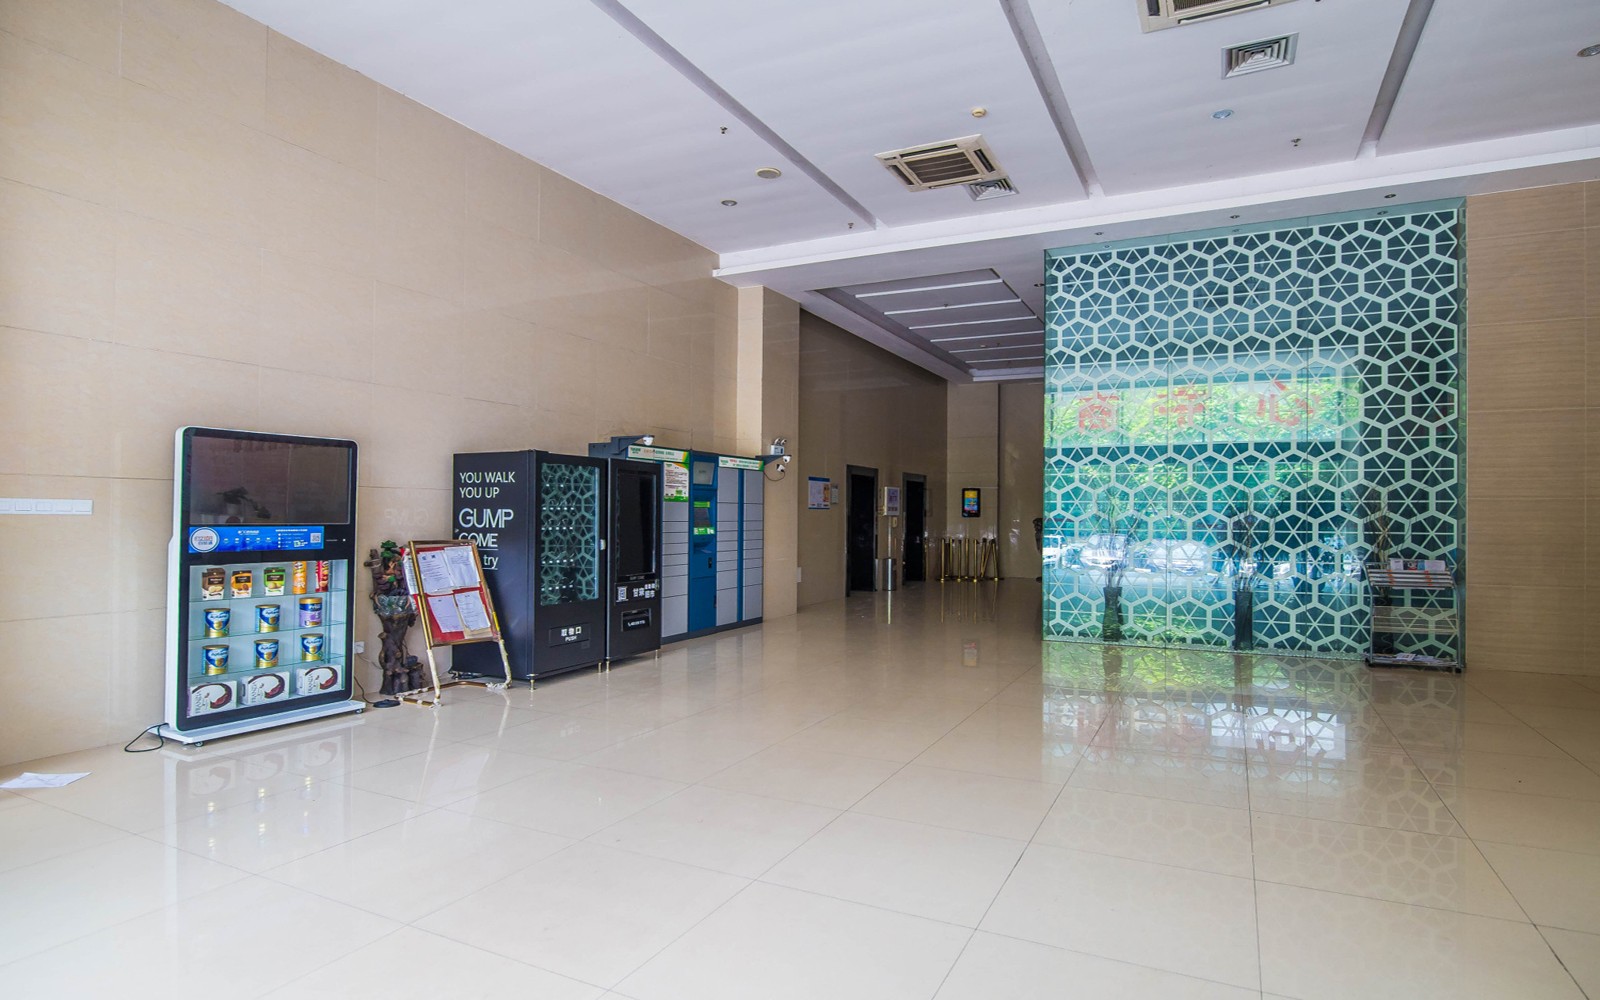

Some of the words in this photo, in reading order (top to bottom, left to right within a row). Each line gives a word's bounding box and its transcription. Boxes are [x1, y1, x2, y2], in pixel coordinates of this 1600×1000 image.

[459, 472, 482, 484] YOU
[484, 471, 516, 483] WALK
[459, 487, 482, 498] YOU
[484, 486, 500, 498] UP
[458, 507, 514, 528] GUMP
[458, 532, 498, 547] COME
[483, 555, 498, 569] try
